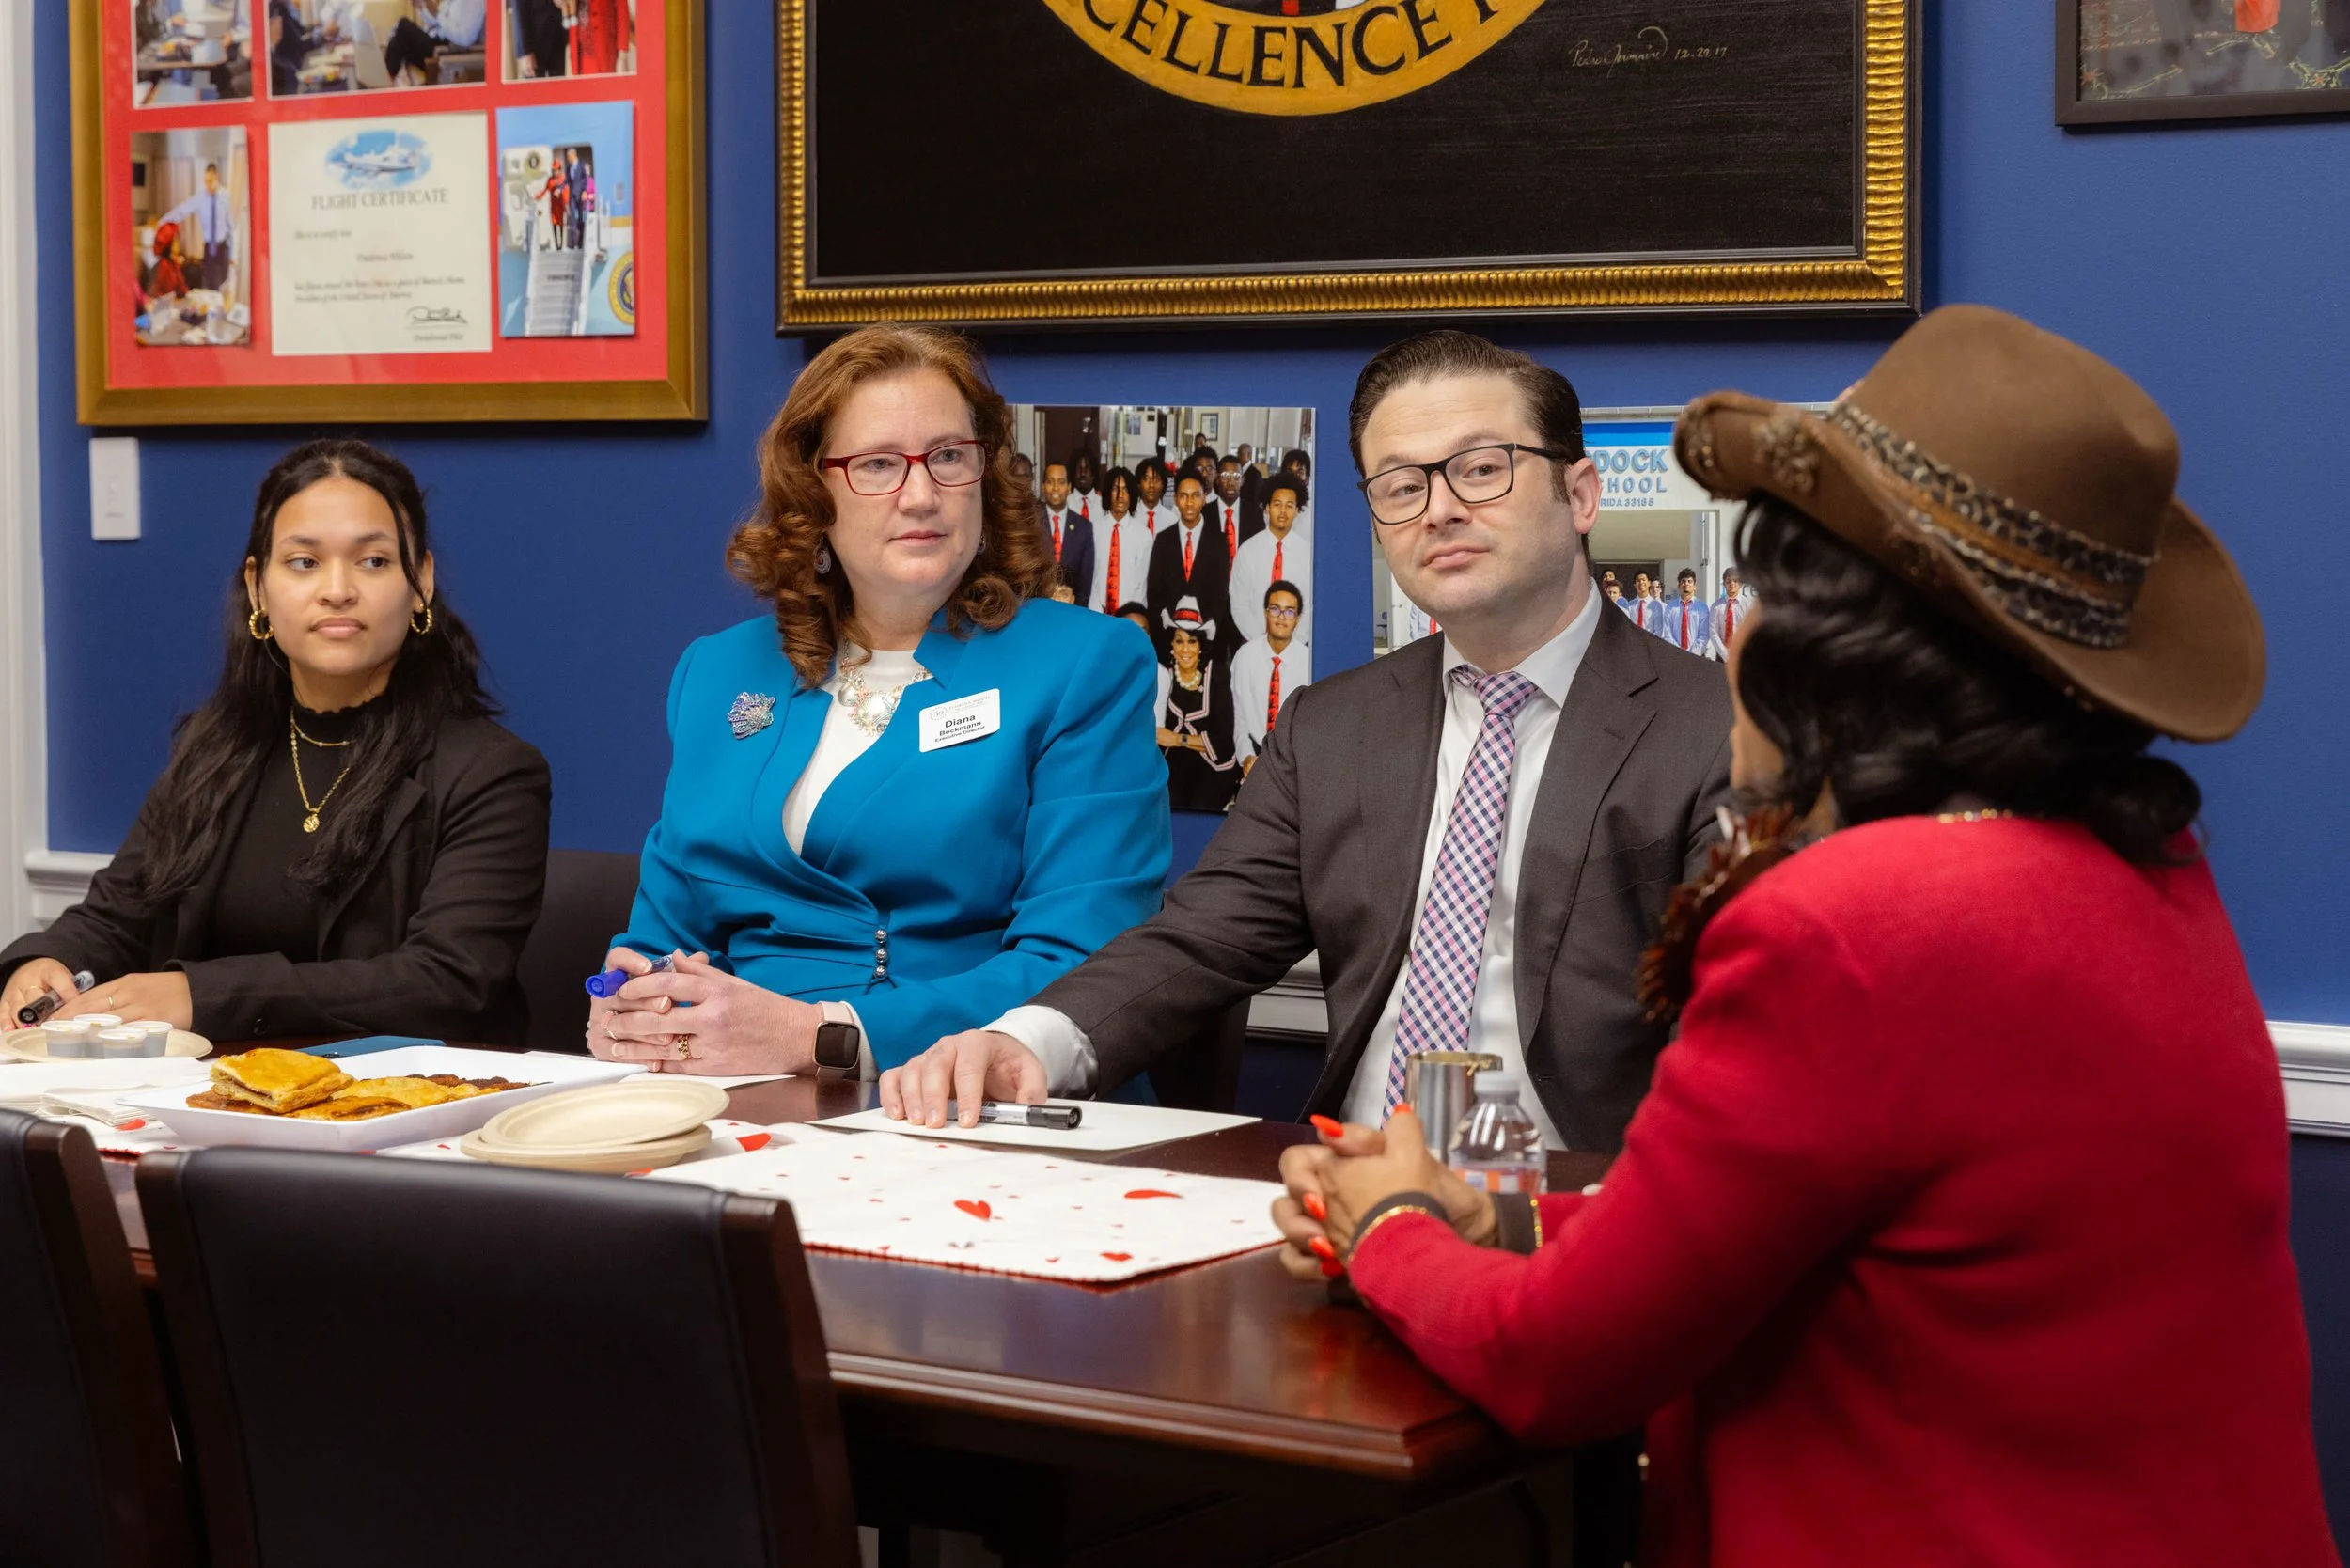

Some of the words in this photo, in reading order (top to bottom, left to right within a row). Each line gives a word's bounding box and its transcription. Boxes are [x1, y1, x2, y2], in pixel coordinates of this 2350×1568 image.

[311, 192, 358, 211] FLIGHT
[361, 188, 449, 208] CERTIFICATE
[1586, 449, 1668, 474] DOCK
[1601, 476, 1668, 493] HOOL
[939, 722, 981, 736] Beckmann
[946, 715, 975, 728] Diana
[935, 732, 962, 742] Executive
[963, 726, 985, 735] Director
